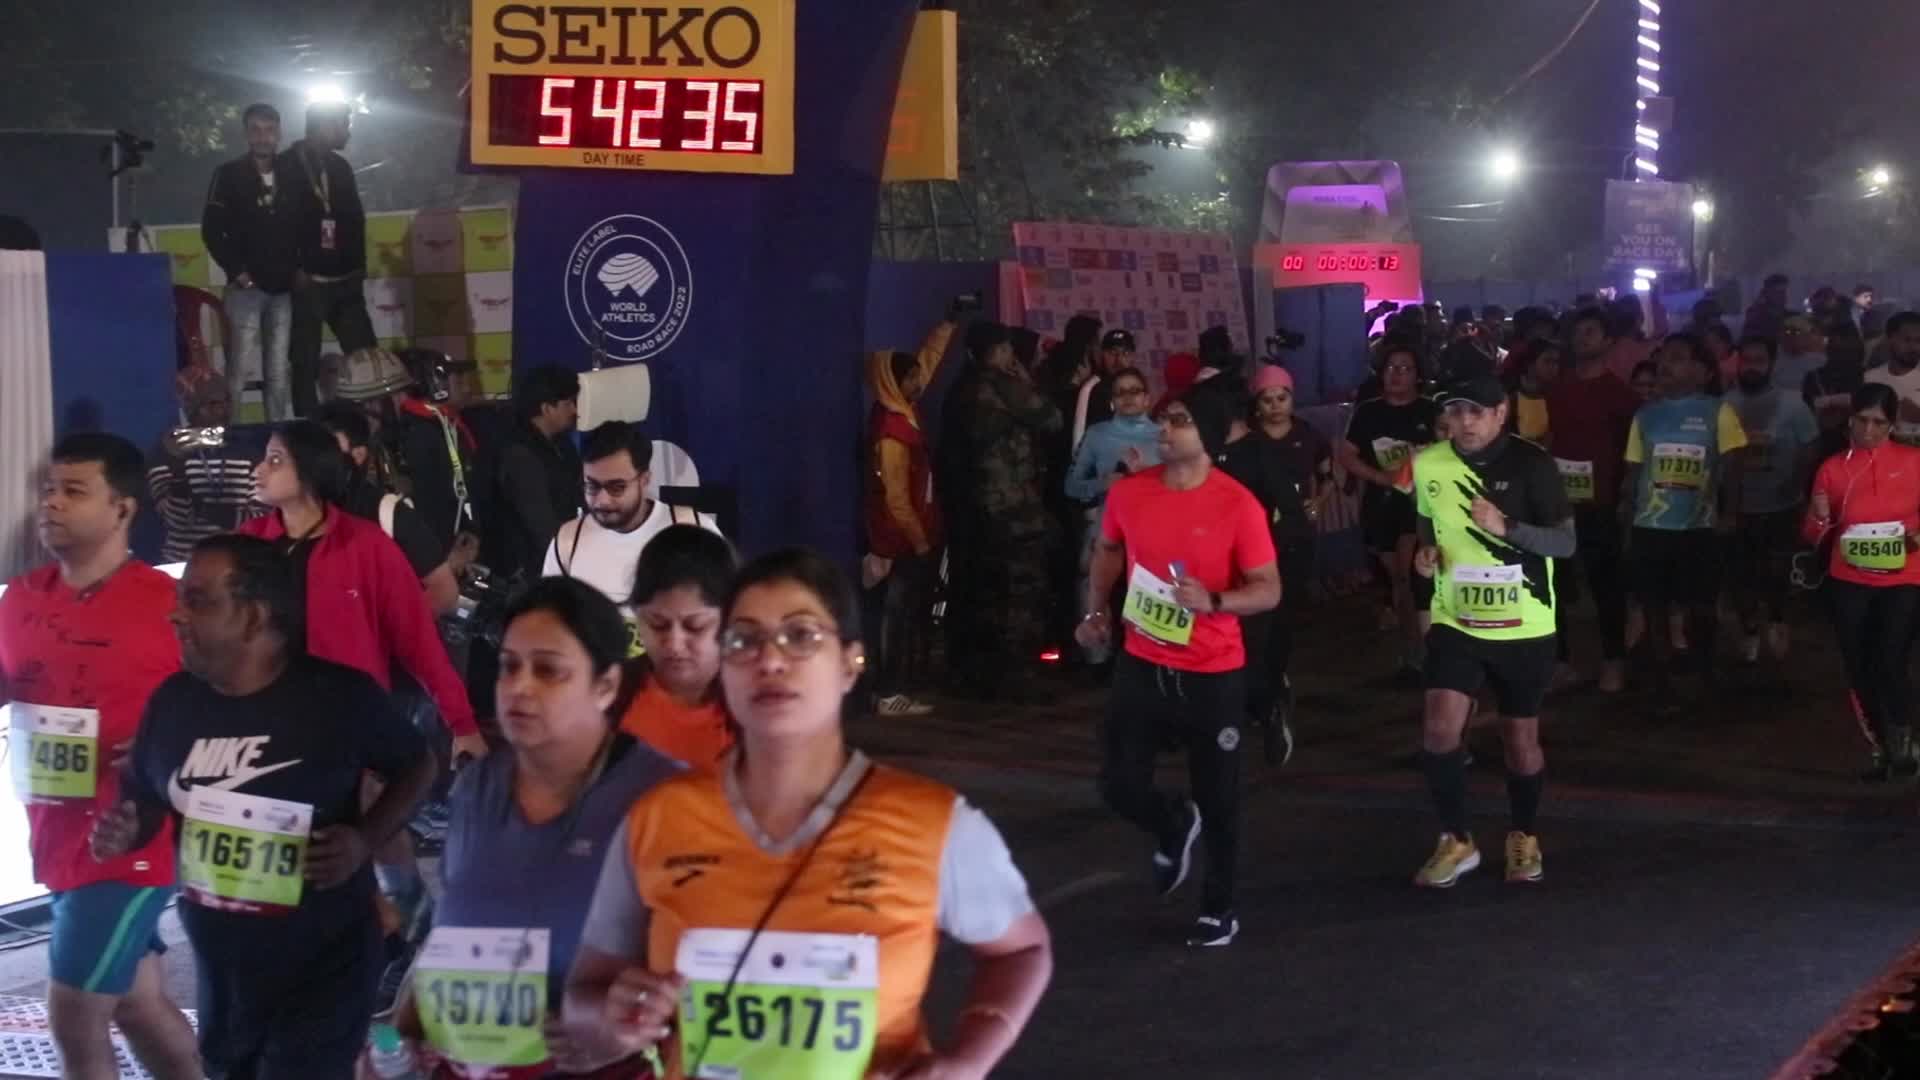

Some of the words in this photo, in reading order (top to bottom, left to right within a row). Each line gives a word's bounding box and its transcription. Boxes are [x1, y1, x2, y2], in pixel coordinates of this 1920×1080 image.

[493, 4, 761, 68] SEIKO
[538, 78, 575, 145] 5
[592, 79, 666, 147] 42
[681, 81, 760, 151] 35
[583, 152, 612, 165] DAY
[614, 153, 645, 167] TIME
[572, 246, 590, 276] ELITE
[586, 224, 617, 248] LABEL
[1613, 246, 1651, 257] RACE
[1621, 235, 1651, 246] YOU
[601, 313, 656, 323] ATHLETICS
[610, 302, 647, 312] WORLD
[626, 338, 656, 353] ROAD
[654, 317, 678, 342] RACE
[673, 285, 687, 318] 2022
[1848, 541, 1902, 556] 26540
[1136, 591, 1189, 629] 19176
[1461, 586, 1518, 606] 17014
[179, 735, 271, 779] NIKE
[195, 829, 298, 877] 16519
[704, 992, 862, 1052] 26175
